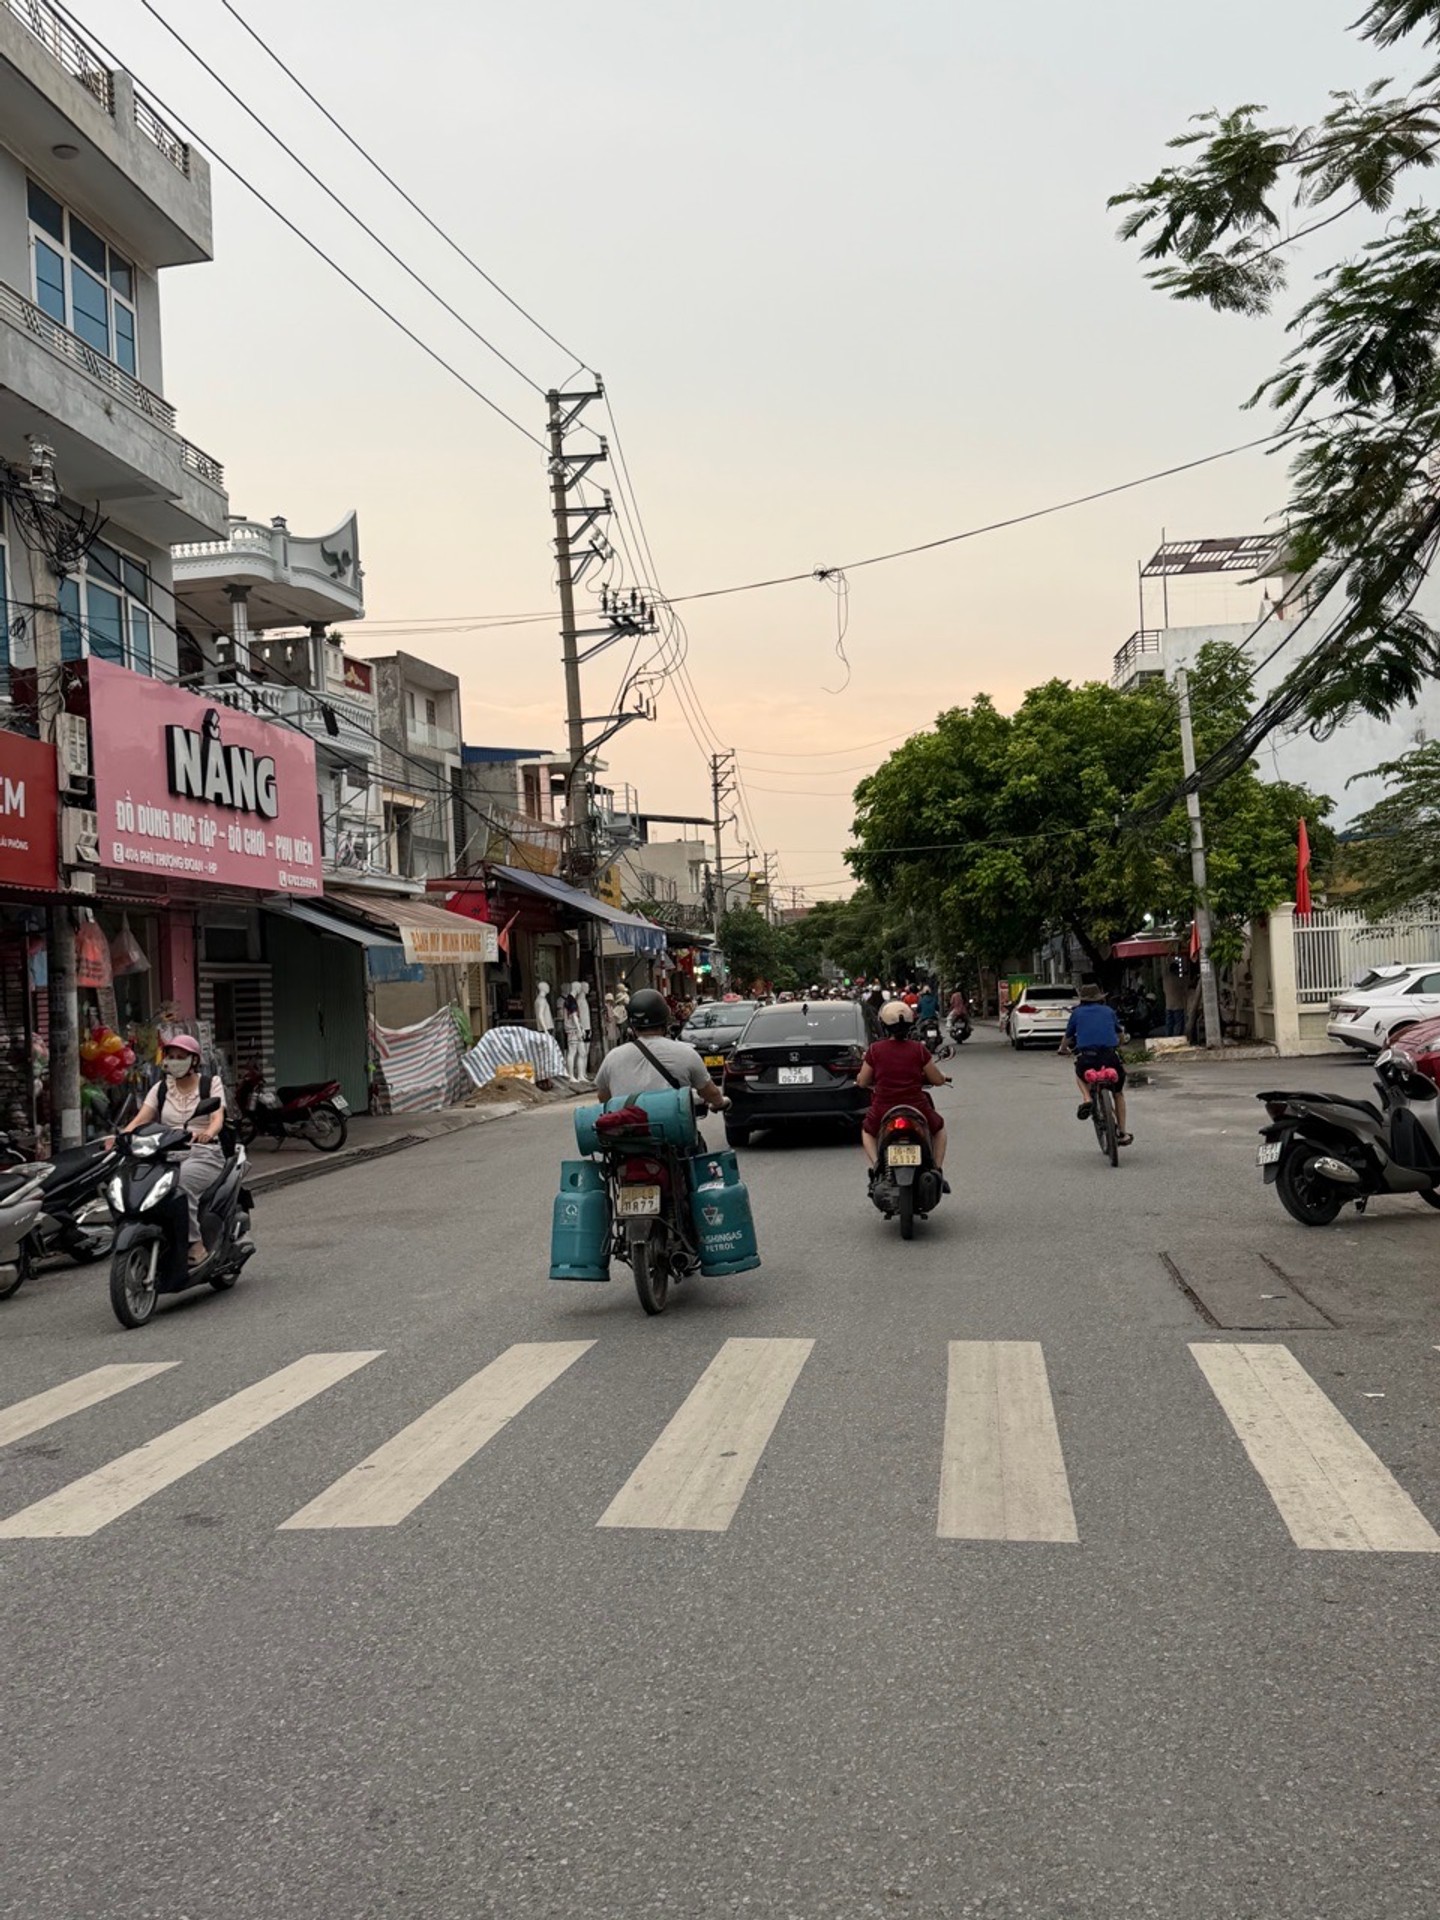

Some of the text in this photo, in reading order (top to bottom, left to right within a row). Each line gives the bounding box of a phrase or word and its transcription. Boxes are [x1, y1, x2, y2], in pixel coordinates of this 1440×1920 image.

[0, 777, 25, 818] M
[138, 800, 170, 839] DÙNG
[173, 812, 196, 849] HỌC
[198, 814, 217, 853] TẬP
